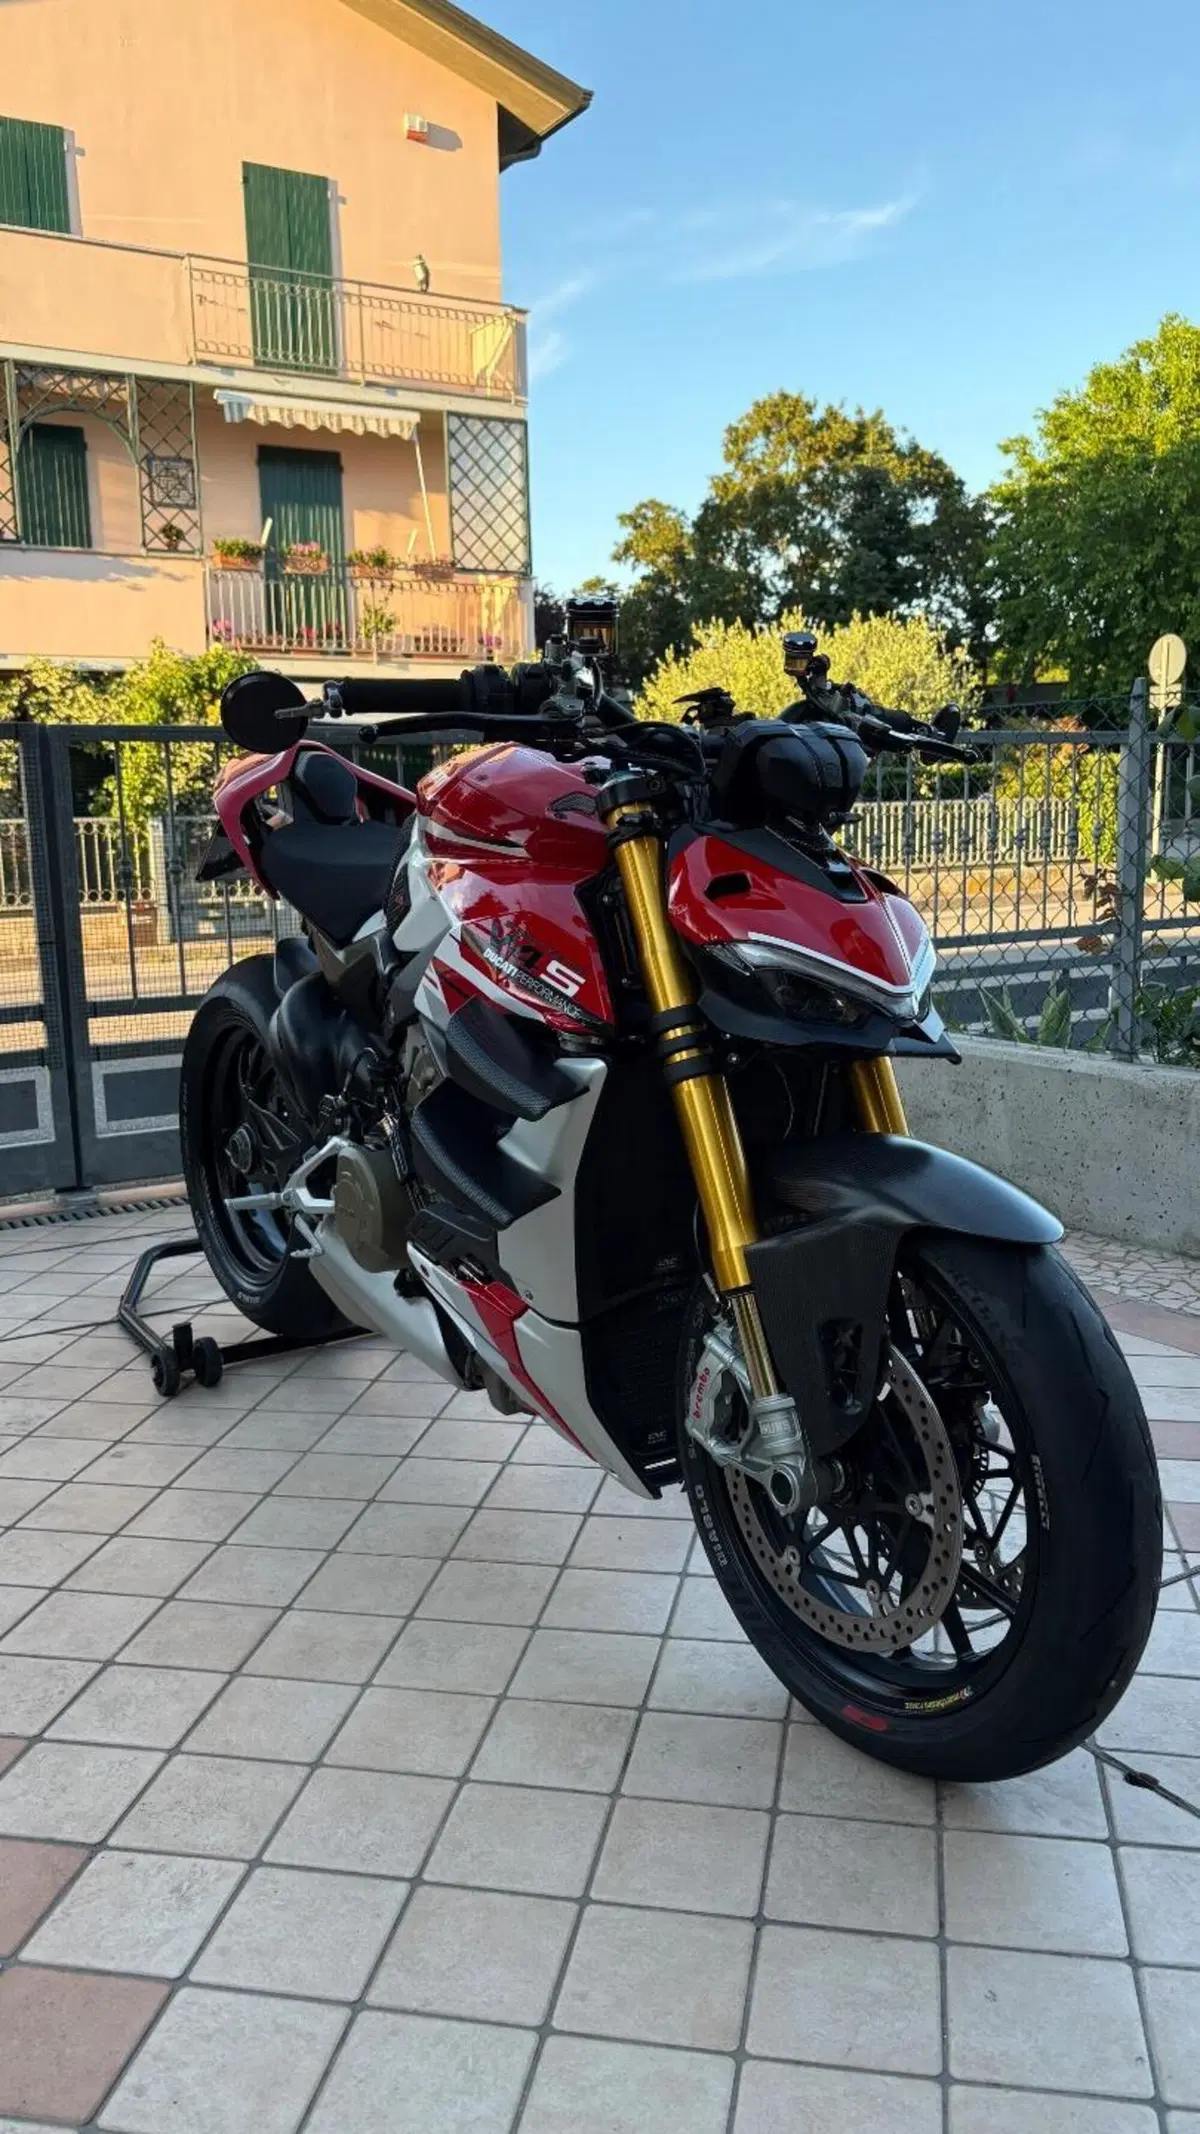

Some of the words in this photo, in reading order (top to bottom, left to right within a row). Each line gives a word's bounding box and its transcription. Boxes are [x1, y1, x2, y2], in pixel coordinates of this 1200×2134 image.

[483, 947, 519, 977] DUCATI
[517, 970, 581, 1019] PERFORMANCE
[693, 1367, 711, 1419] brembo
